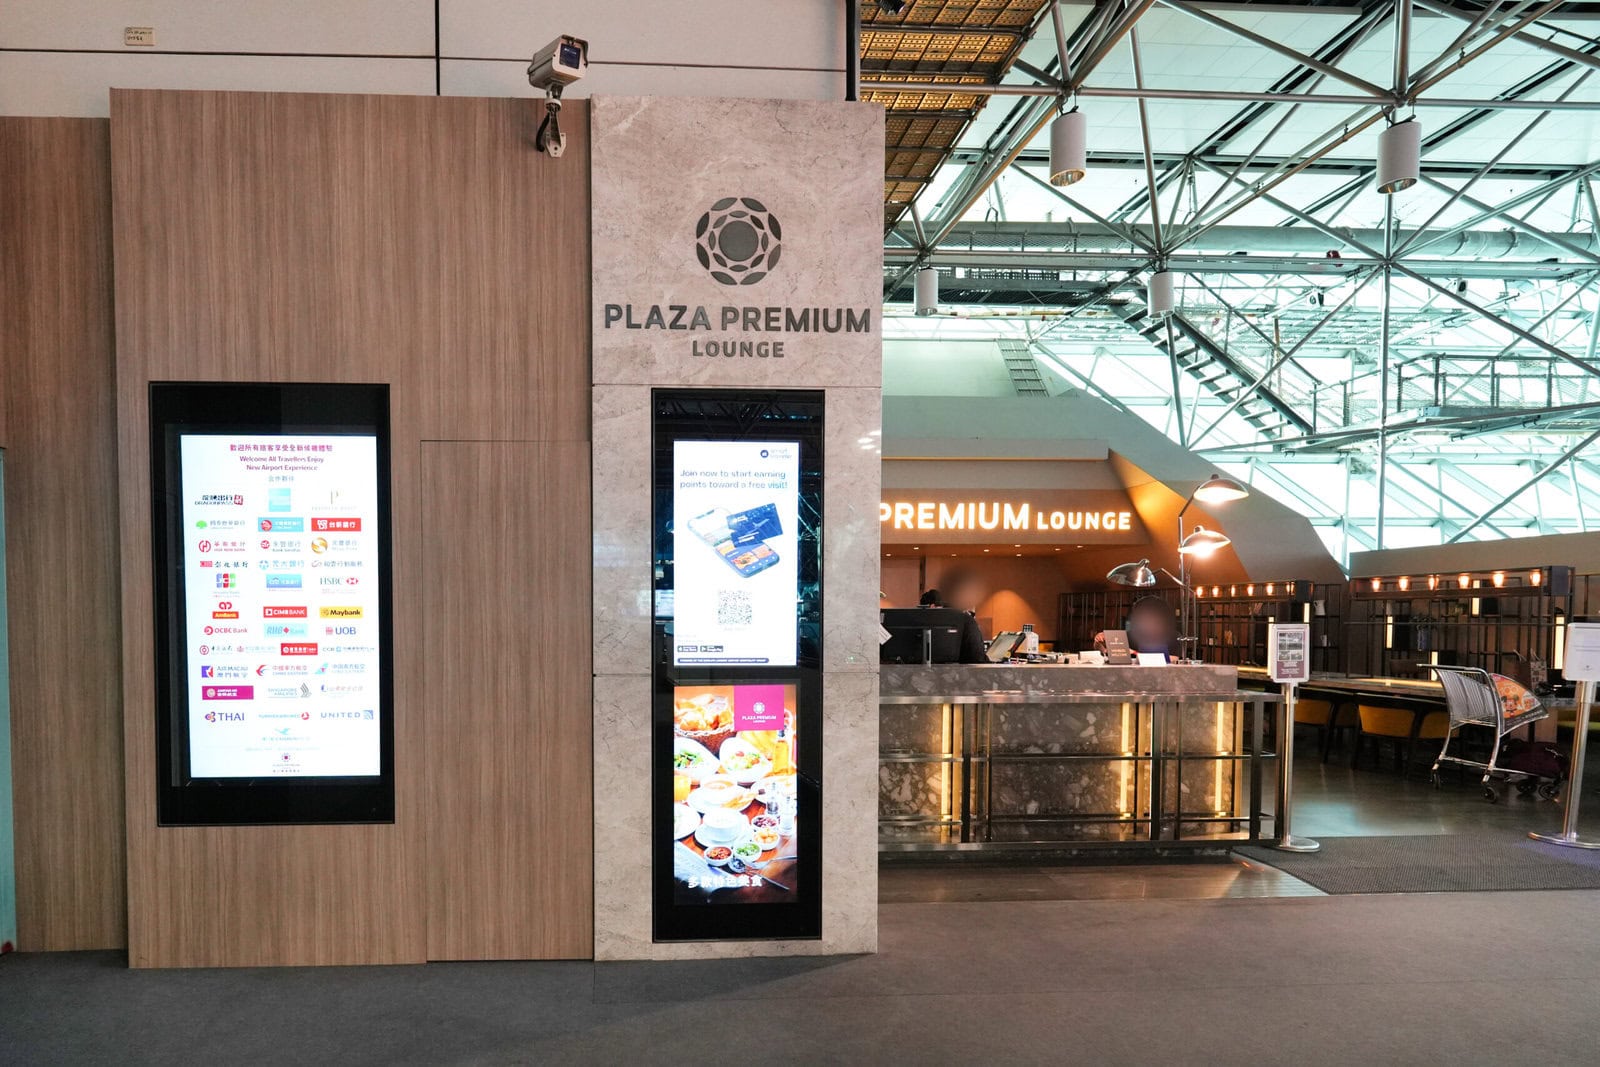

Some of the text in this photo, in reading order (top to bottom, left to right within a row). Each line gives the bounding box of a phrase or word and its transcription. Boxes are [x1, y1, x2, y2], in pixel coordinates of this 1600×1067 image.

[604, 304, 871, 333] PLAZA PREMIUM
[692, 340, 785, 358] LOUNGE
[307, 456, 324, 464] Enjoy
[262, 464, 283, 472] Airport
[284, 464, 318, 472] Experience
[732, 470, 751, 478] start
[754, 471, 786, 480] earning
[680, 481, 707, 489] points
[767, 481, 788, 489] visit!
[880, 502, 1132, 530] PREMIUM LOUNGE
[330, 609, 360, 617] Maybank
[335, 626, 356, 636] UOB
[218, 712, 245, 721] THAI
